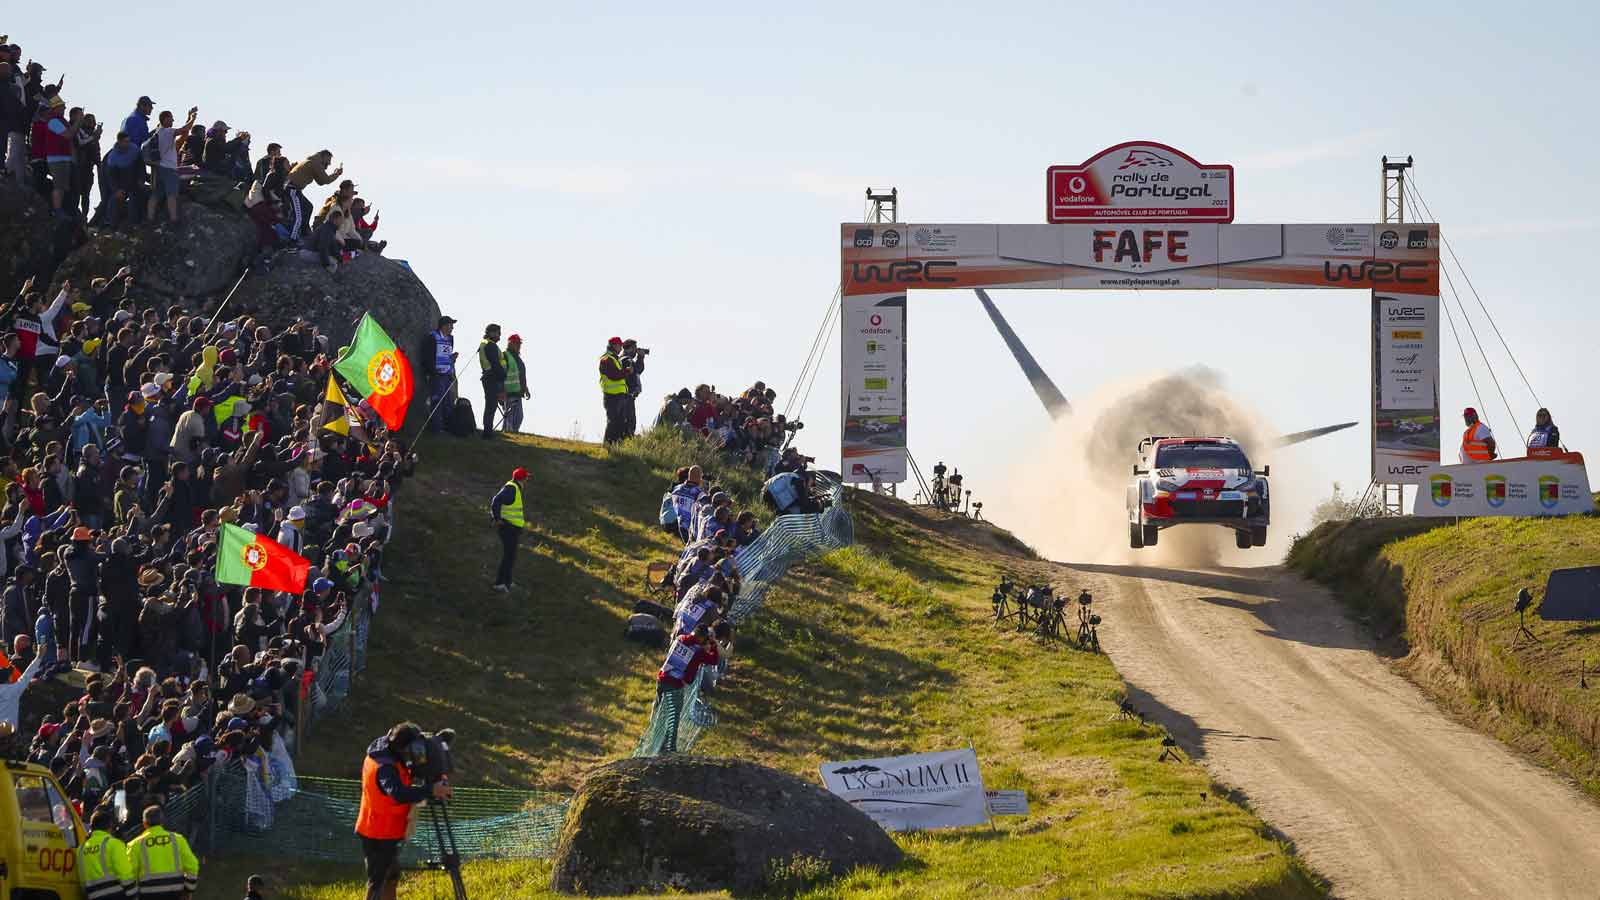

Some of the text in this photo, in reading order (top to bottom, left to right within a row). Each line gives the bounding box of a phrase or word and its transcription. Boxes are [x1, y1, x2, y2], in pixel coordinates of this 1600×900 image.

[1113, 173, 1169, 184] rally de
[1059, 195, 1096, 203] vodafone
[1111, 184, 1212, 200] Portugal
[1093, 229, 1189, 263] FAFE
[853, 261, 957, 283] WRC
[1324, 260, 1428, 283] WRC
[1100, 278, 1180, 286] www.rallydeportugal.pt
[1388, 306, 1425, 316] WRC
[842, 763, 969, 790] LIGNUM II
